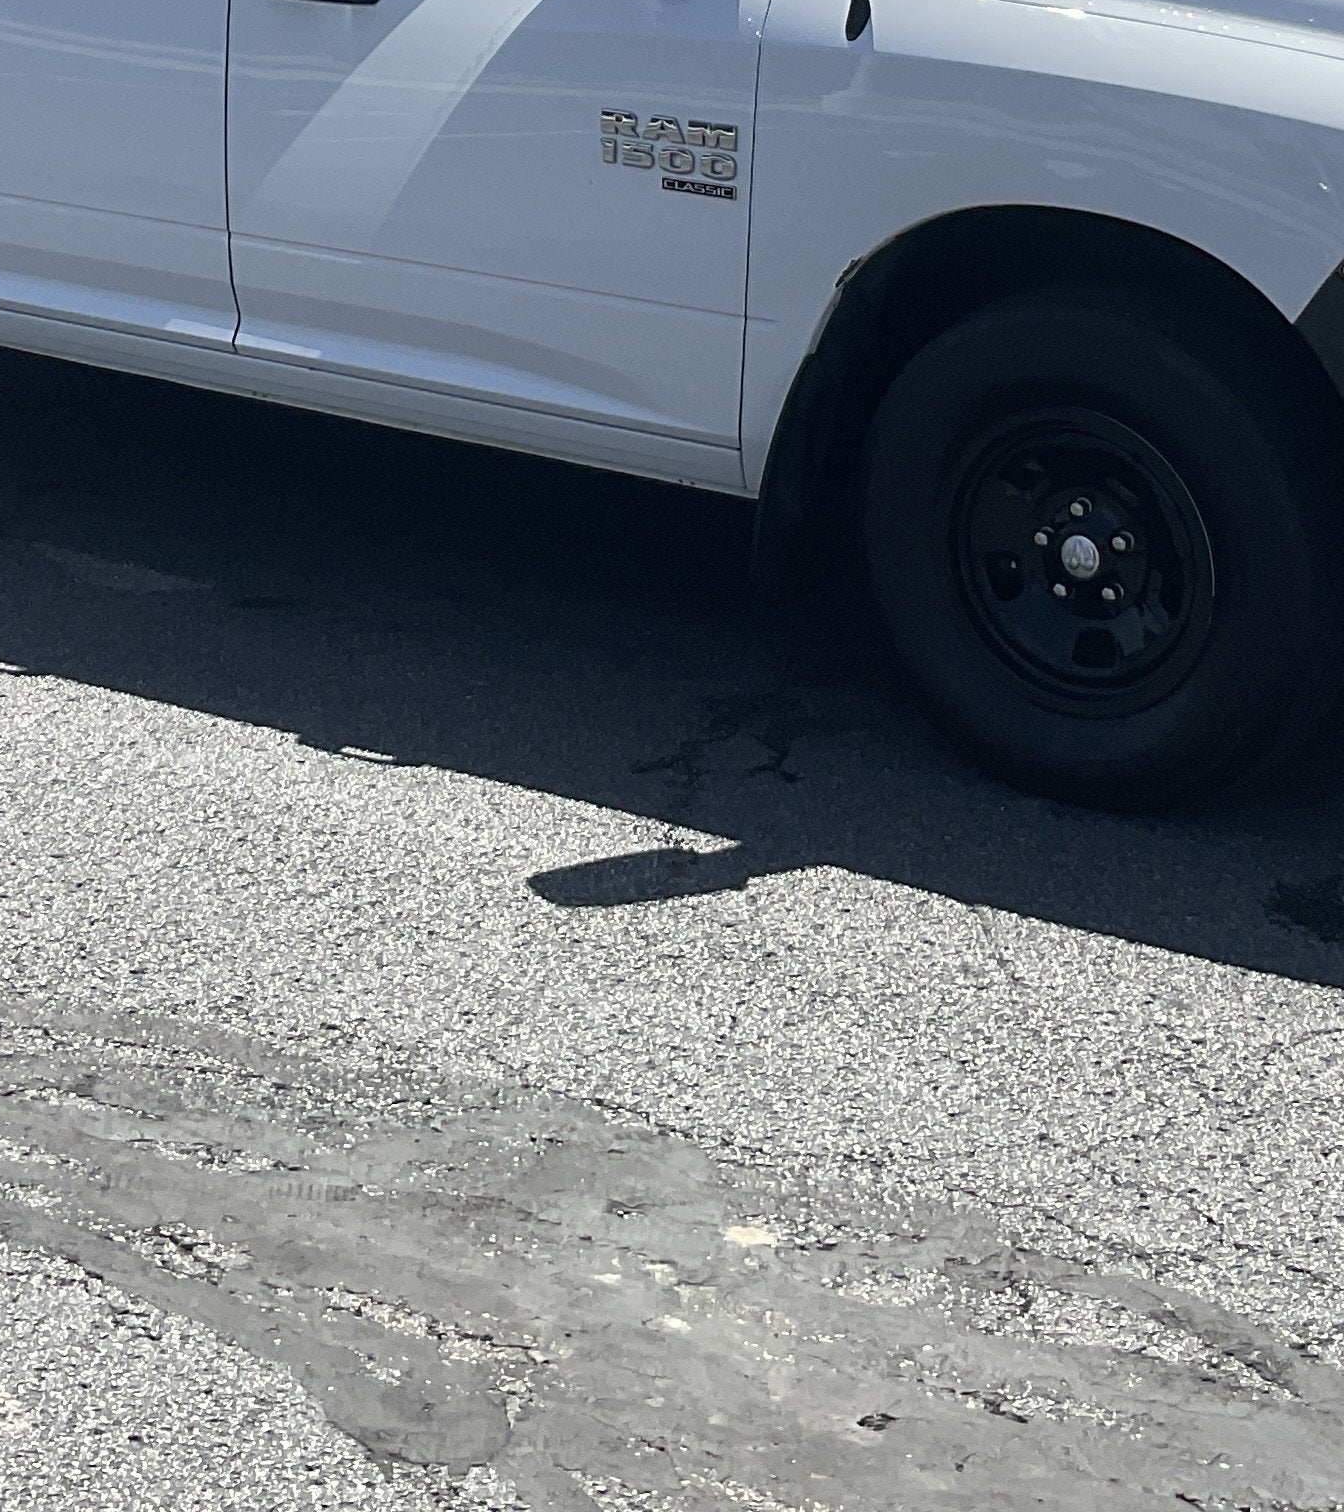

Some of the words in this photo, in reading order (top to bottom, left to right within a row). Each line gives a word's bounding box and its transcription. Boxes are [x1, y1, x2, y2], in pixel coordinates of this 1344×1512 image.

[600, 107, 738, 152] RAM
[600, 136, 737, 182] 1500
[662, 177, 733, 199] CLASSIC
